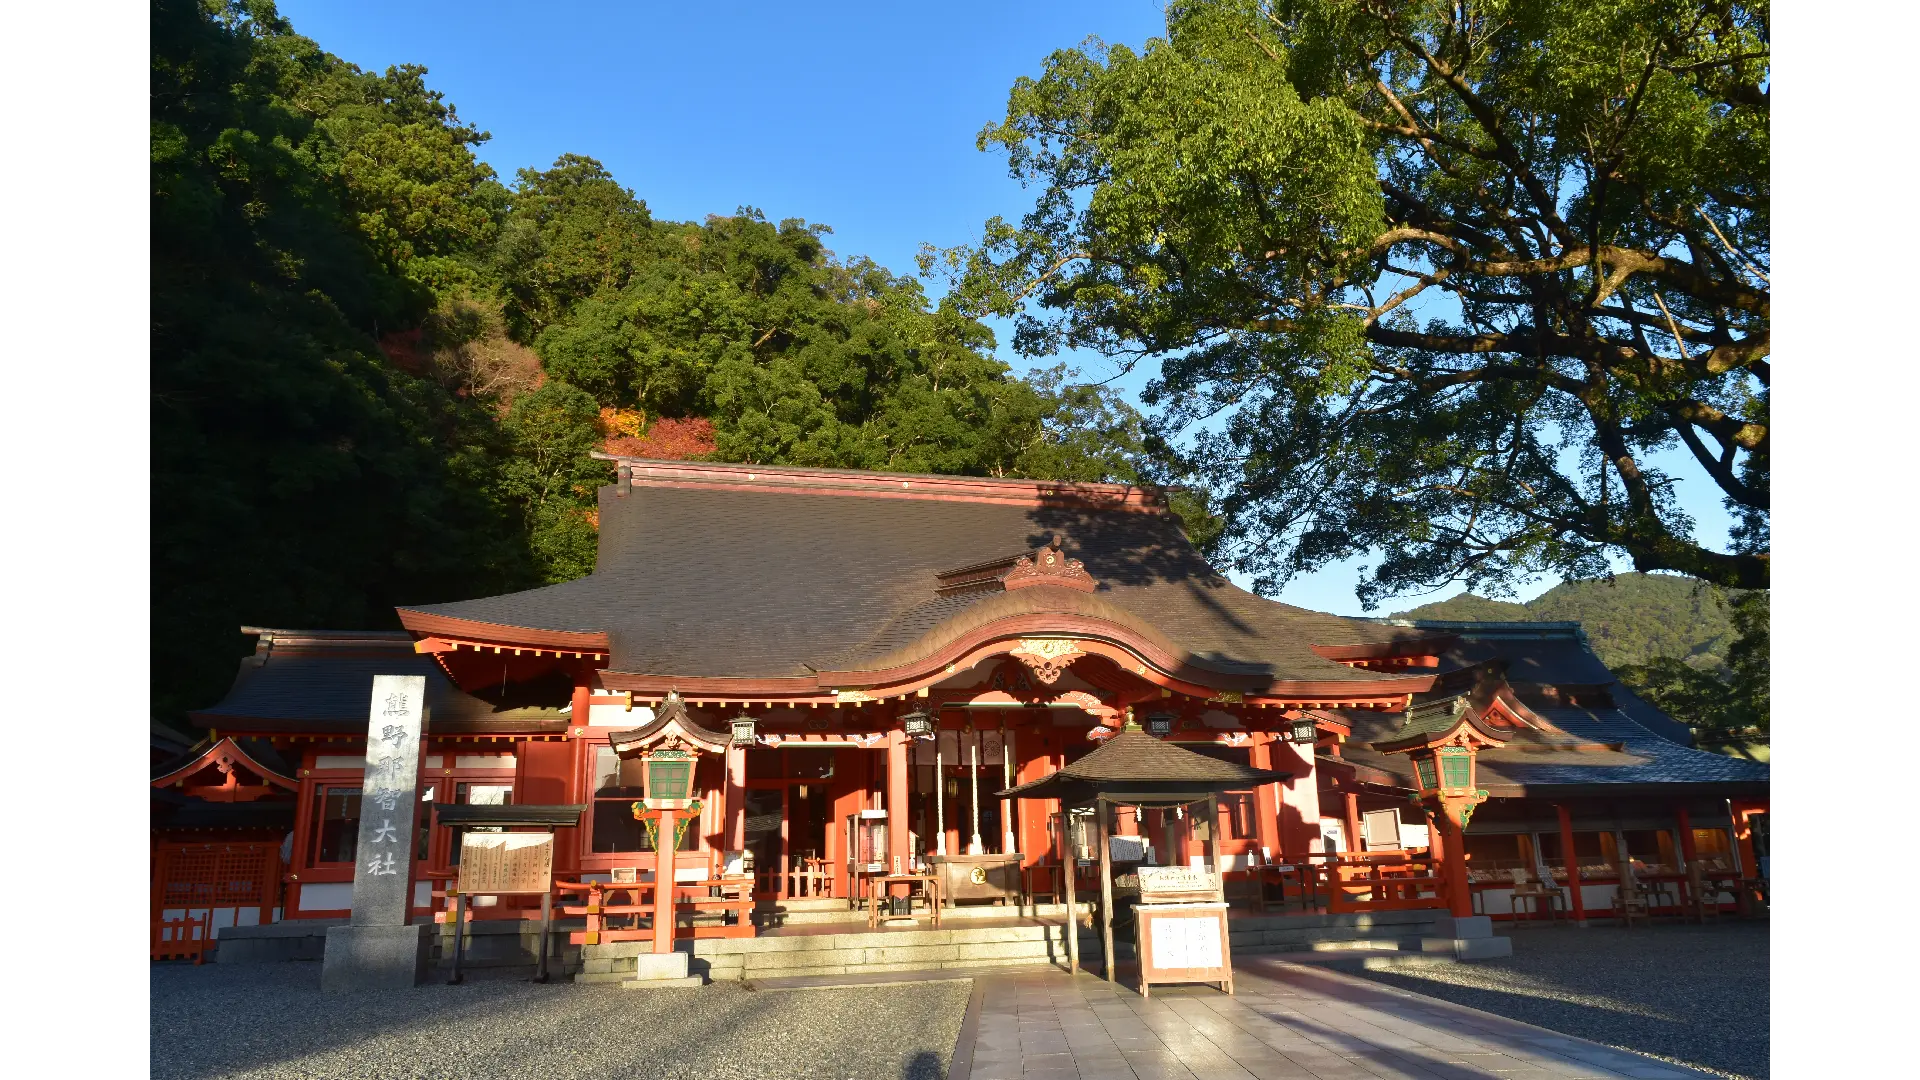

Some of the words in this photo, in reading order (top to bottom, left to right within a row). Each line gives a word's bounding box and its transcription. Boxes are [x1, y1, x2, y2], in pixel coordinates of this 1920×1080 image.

[367, 692, 410, 876] 熊野那智大社
